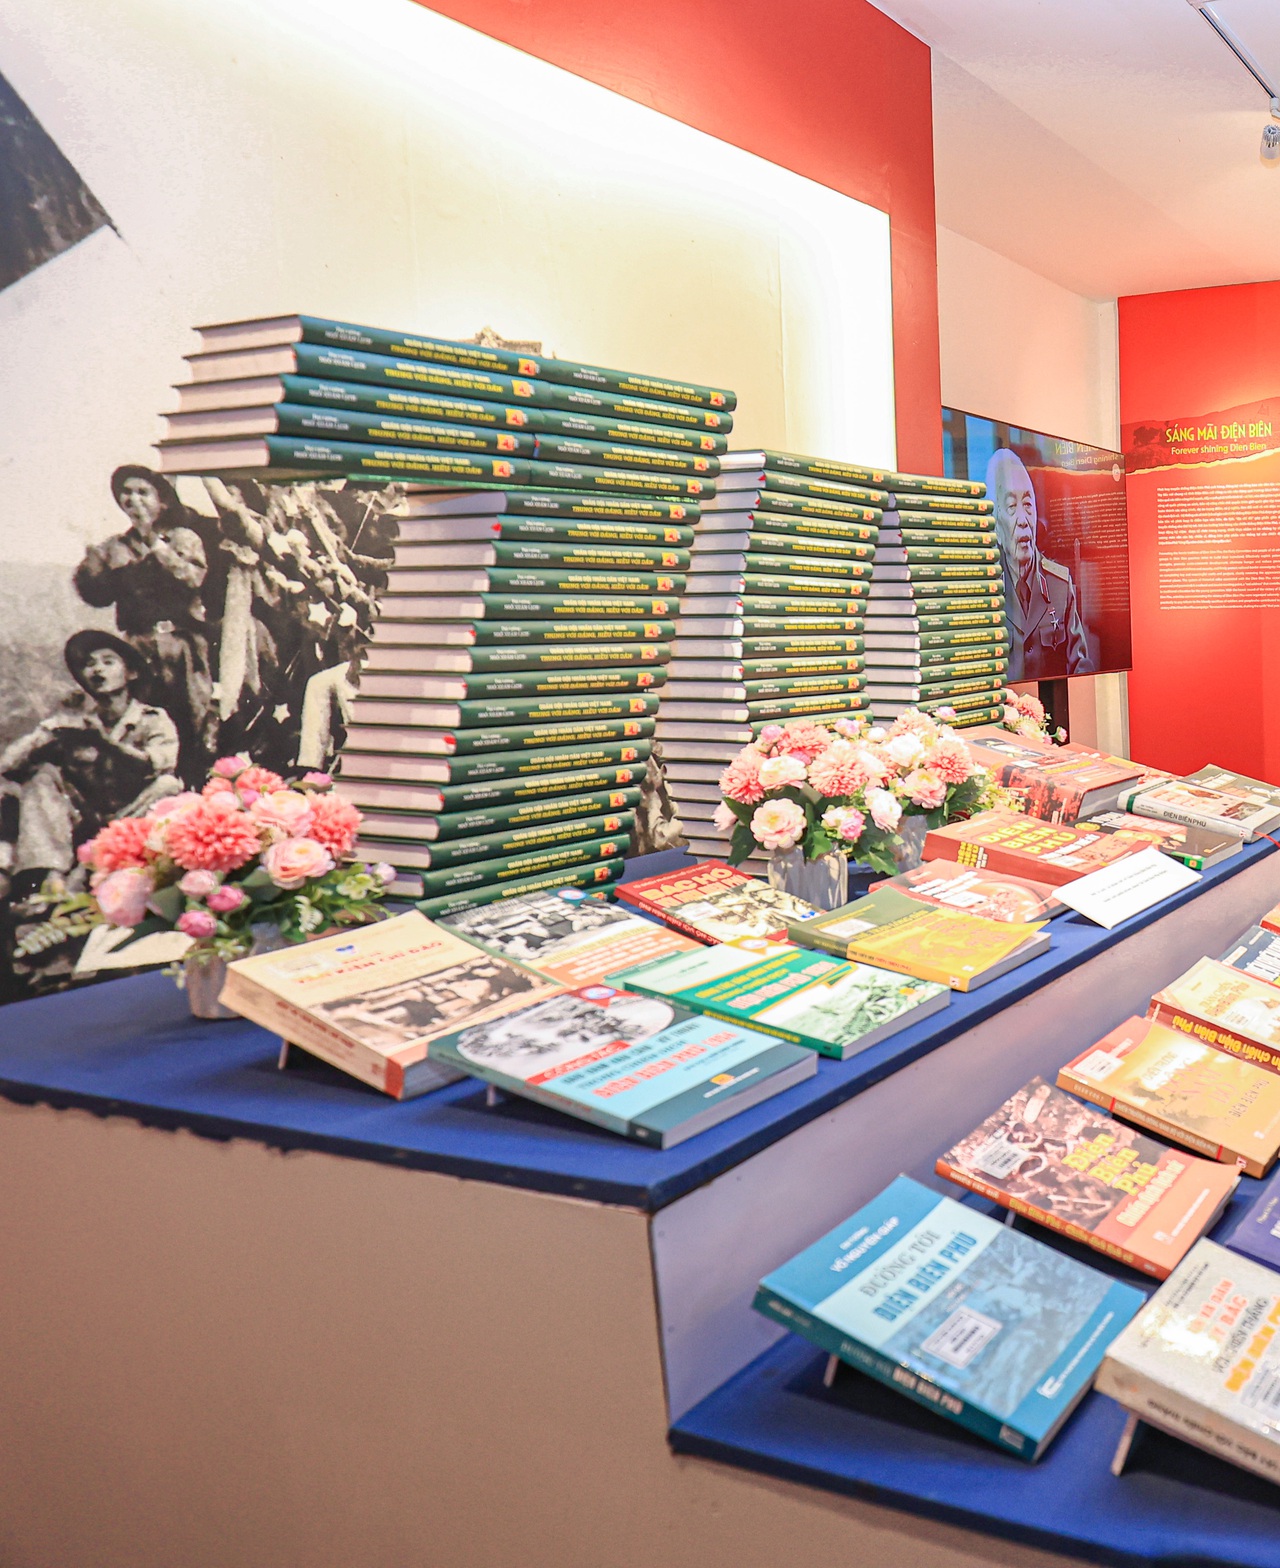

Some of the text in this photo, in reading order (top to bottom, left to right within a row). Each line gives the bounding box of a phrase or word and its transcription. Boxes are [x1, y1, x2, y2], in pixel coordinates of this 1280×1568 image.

[1166, 420, 1272, 442] SÁNG MÃI ĐIỆN BIÊN
[1201, 445, 1228, 453] shining
[1230, 444, 1248, 452] Dien
[639, 866, 734, 900] BÁC HỒ
[1170, 1014, 1193, 1033] Phủ
[1192, 1023, 1217, 1043] Biên
[1216, 1031, 1242, 1052] Điện
[1240, 1043, 1271, 1065] chiến
[1062, 1130, 1116, 1172] Điện
[1088, 1144, 1139, 1182] Biên
[1112, 1160, 1158, 1195] Phủ
[872, 1288, 921, 1323] ĐIỆN
[905, 1258, 949, 1290] BIÊN
[935, 1229, 979, 1259] PHỦ
